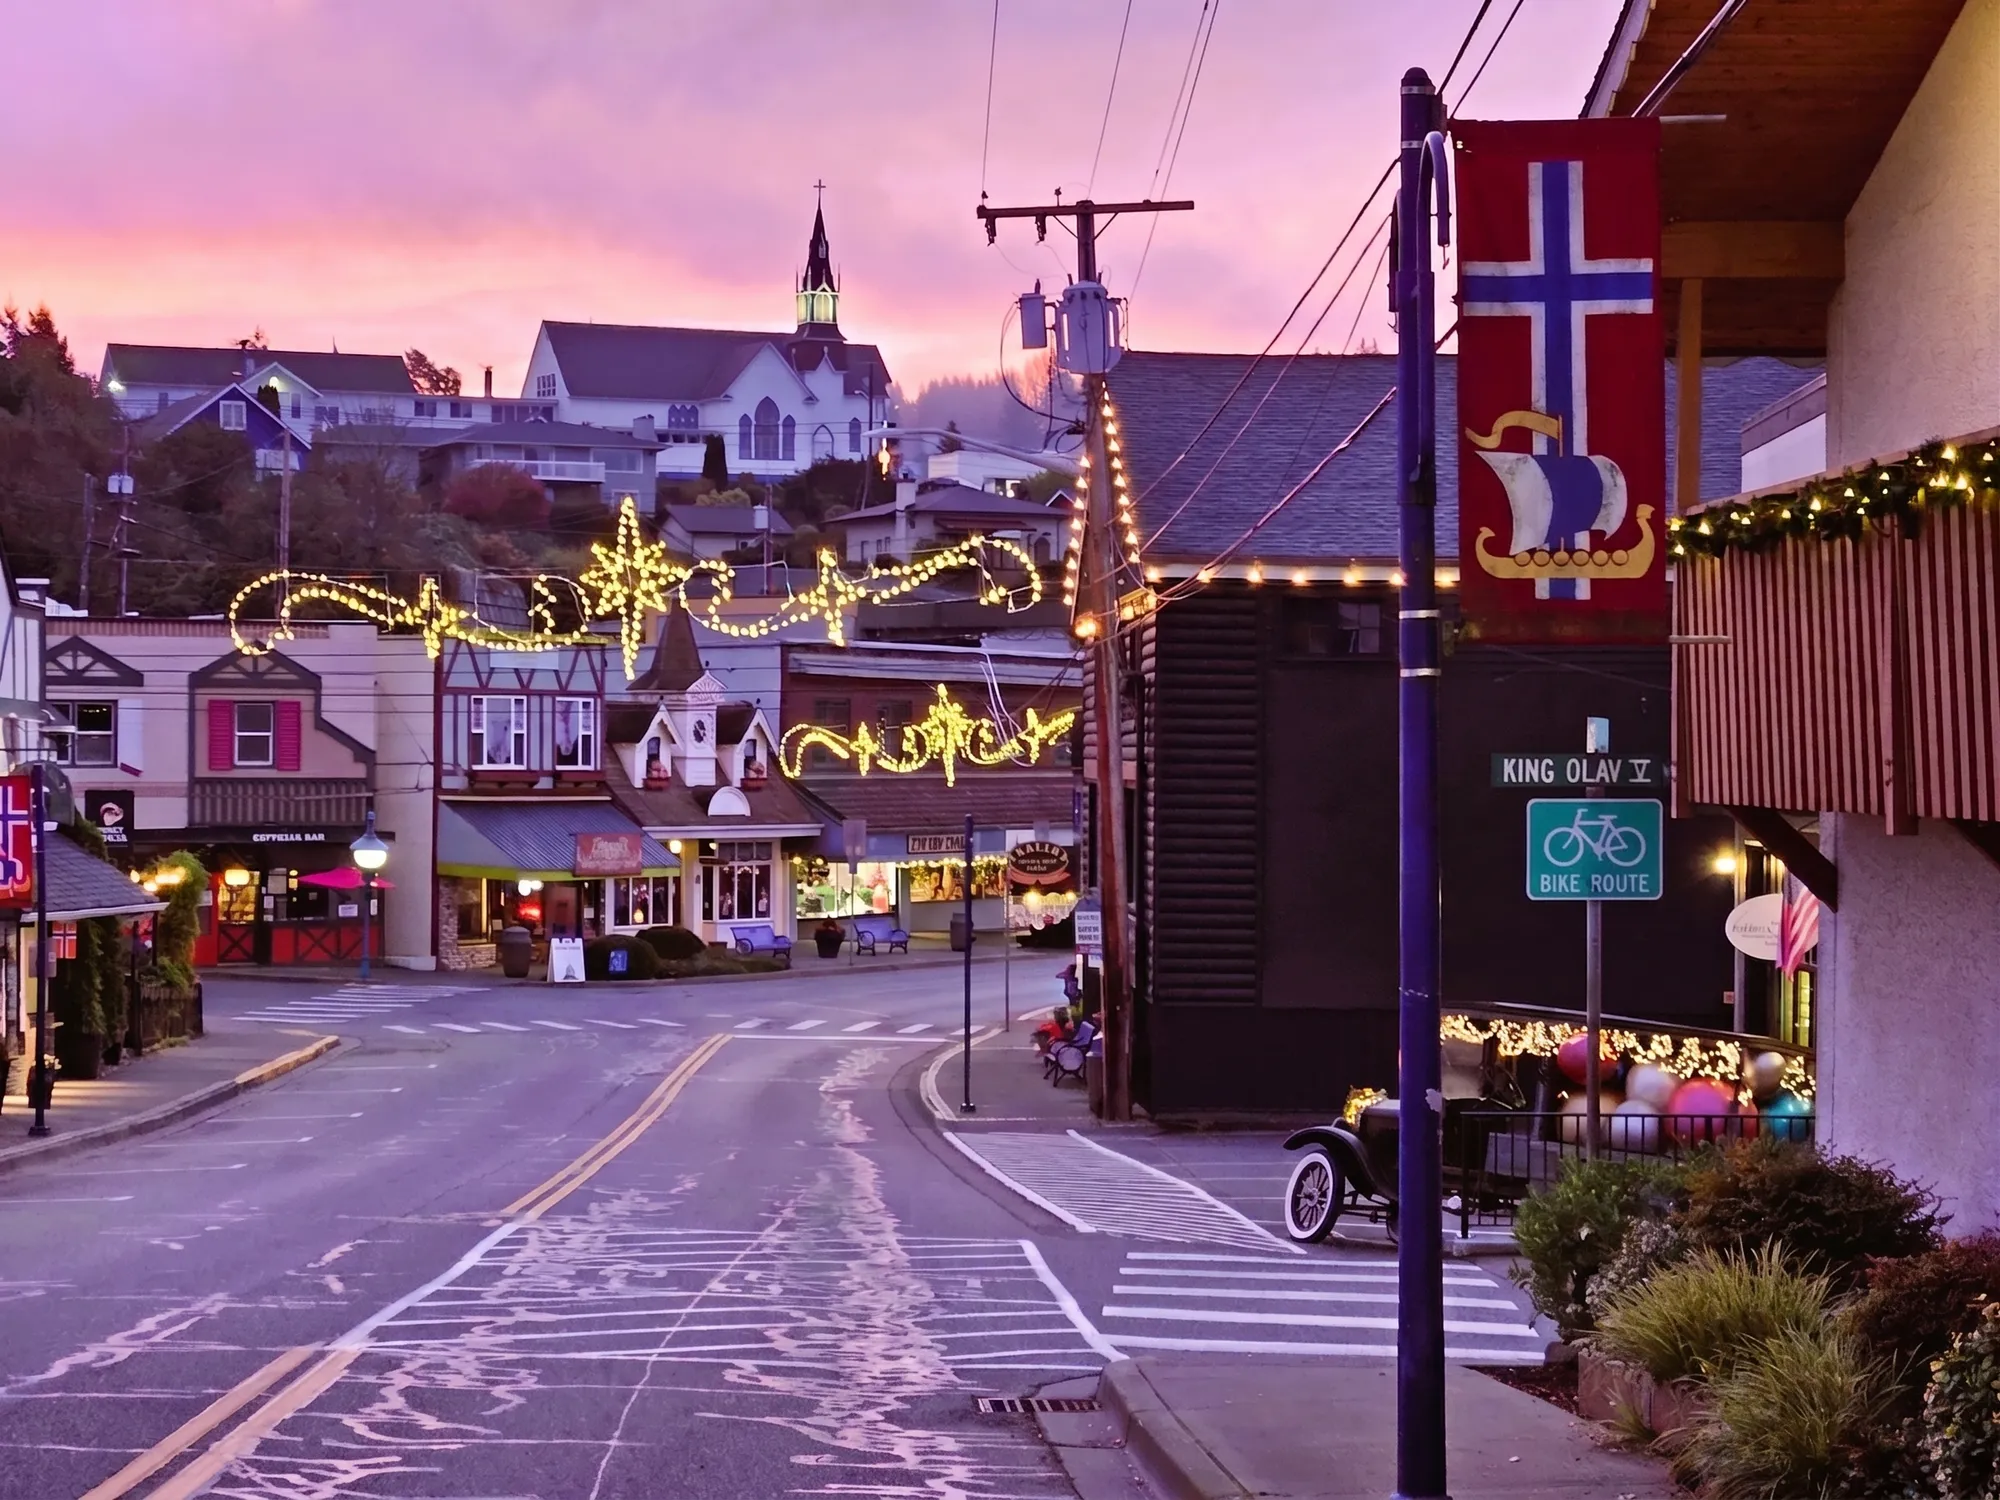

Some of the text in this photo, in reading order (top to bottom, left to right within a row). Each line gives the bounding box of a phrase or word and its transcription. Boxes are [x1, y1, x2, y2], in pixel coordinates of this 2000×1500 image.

[1503, 758, 1652, 783] KING OLAV V
[1540, 874, 1650, 893] BIKE ROUTE
